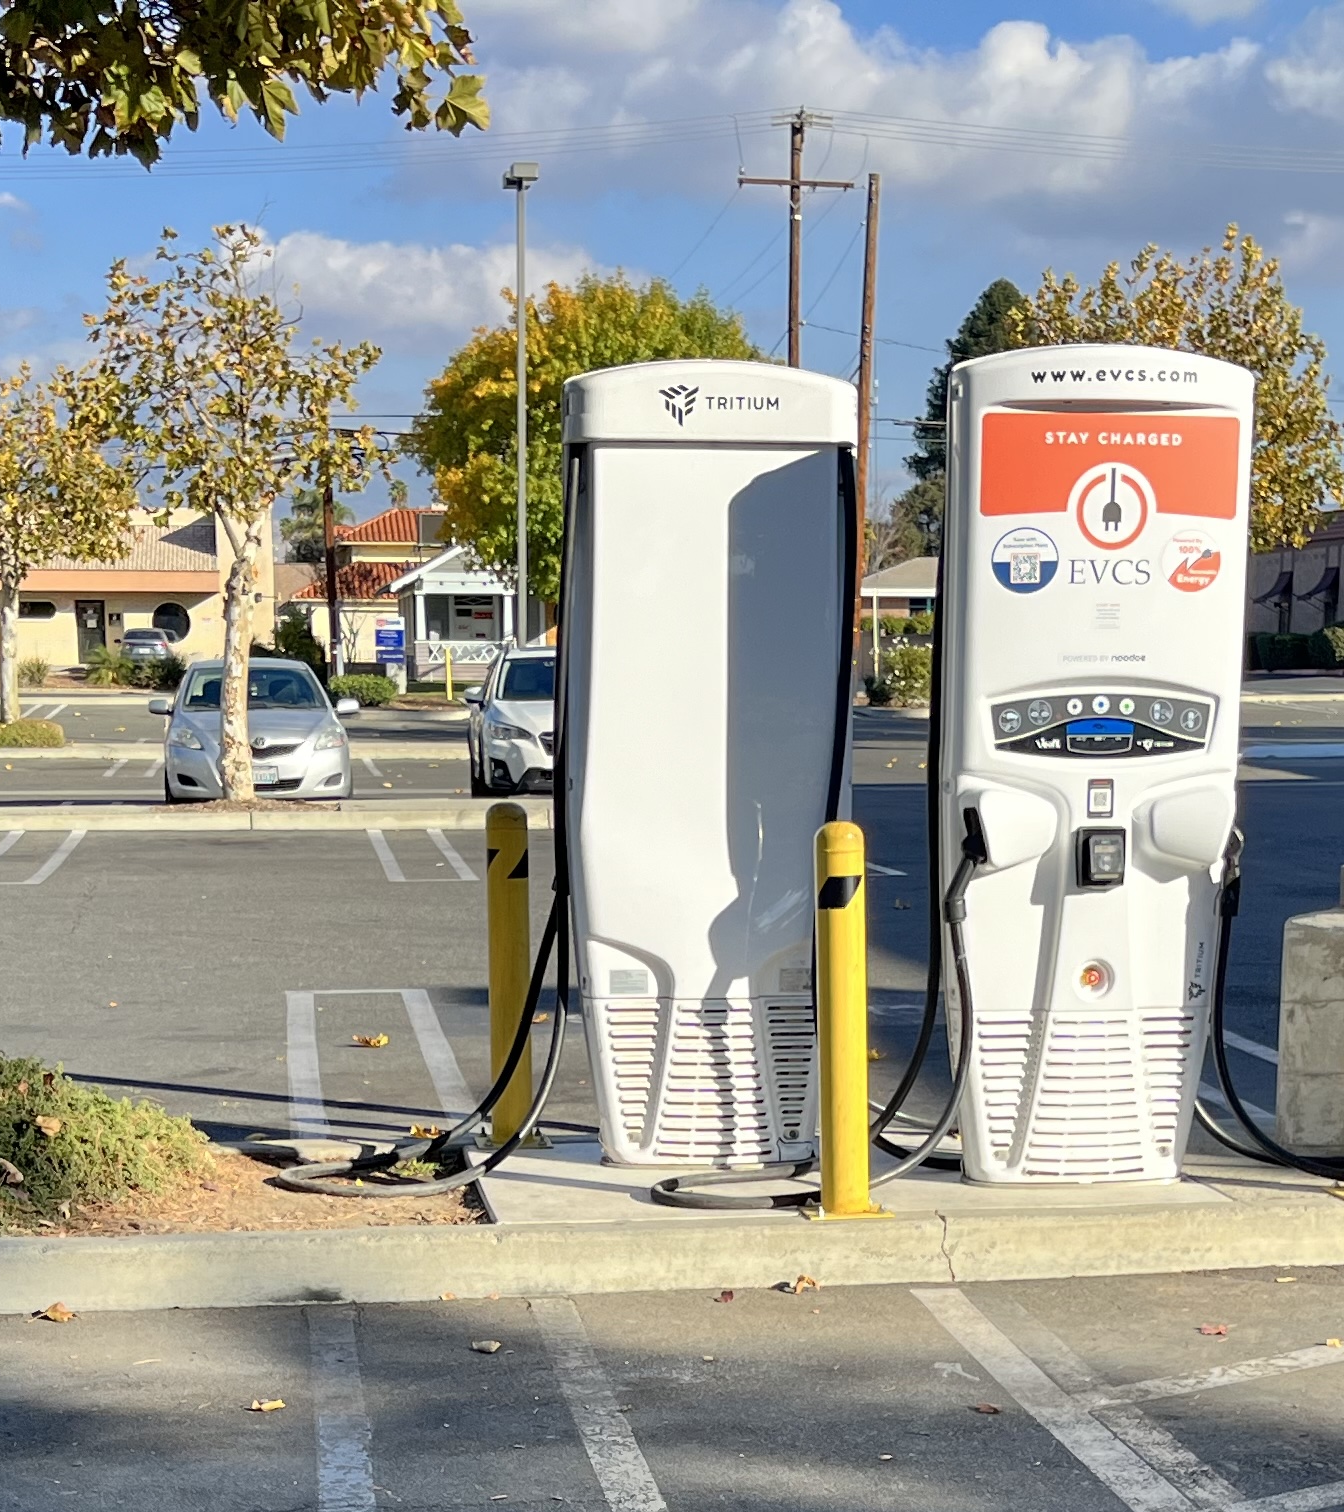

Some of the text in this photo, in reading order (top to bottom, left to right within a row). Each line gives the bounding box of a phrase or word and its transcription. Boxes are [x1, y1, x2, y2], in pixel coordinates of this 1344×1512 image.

[1031, 368, 1198, 384] www.evcs.com
[705, 396, 780, 411] TRITIUM
[1045, 431, 1183, 447] STAY CHARGED
[1067, 559, 1151, 586] EVCS
[1176, 573, 1211, 586] Energy
[1062, 654, 1098, 663] POWERED
[1194, 941, 1205, 979] TRITIUM
